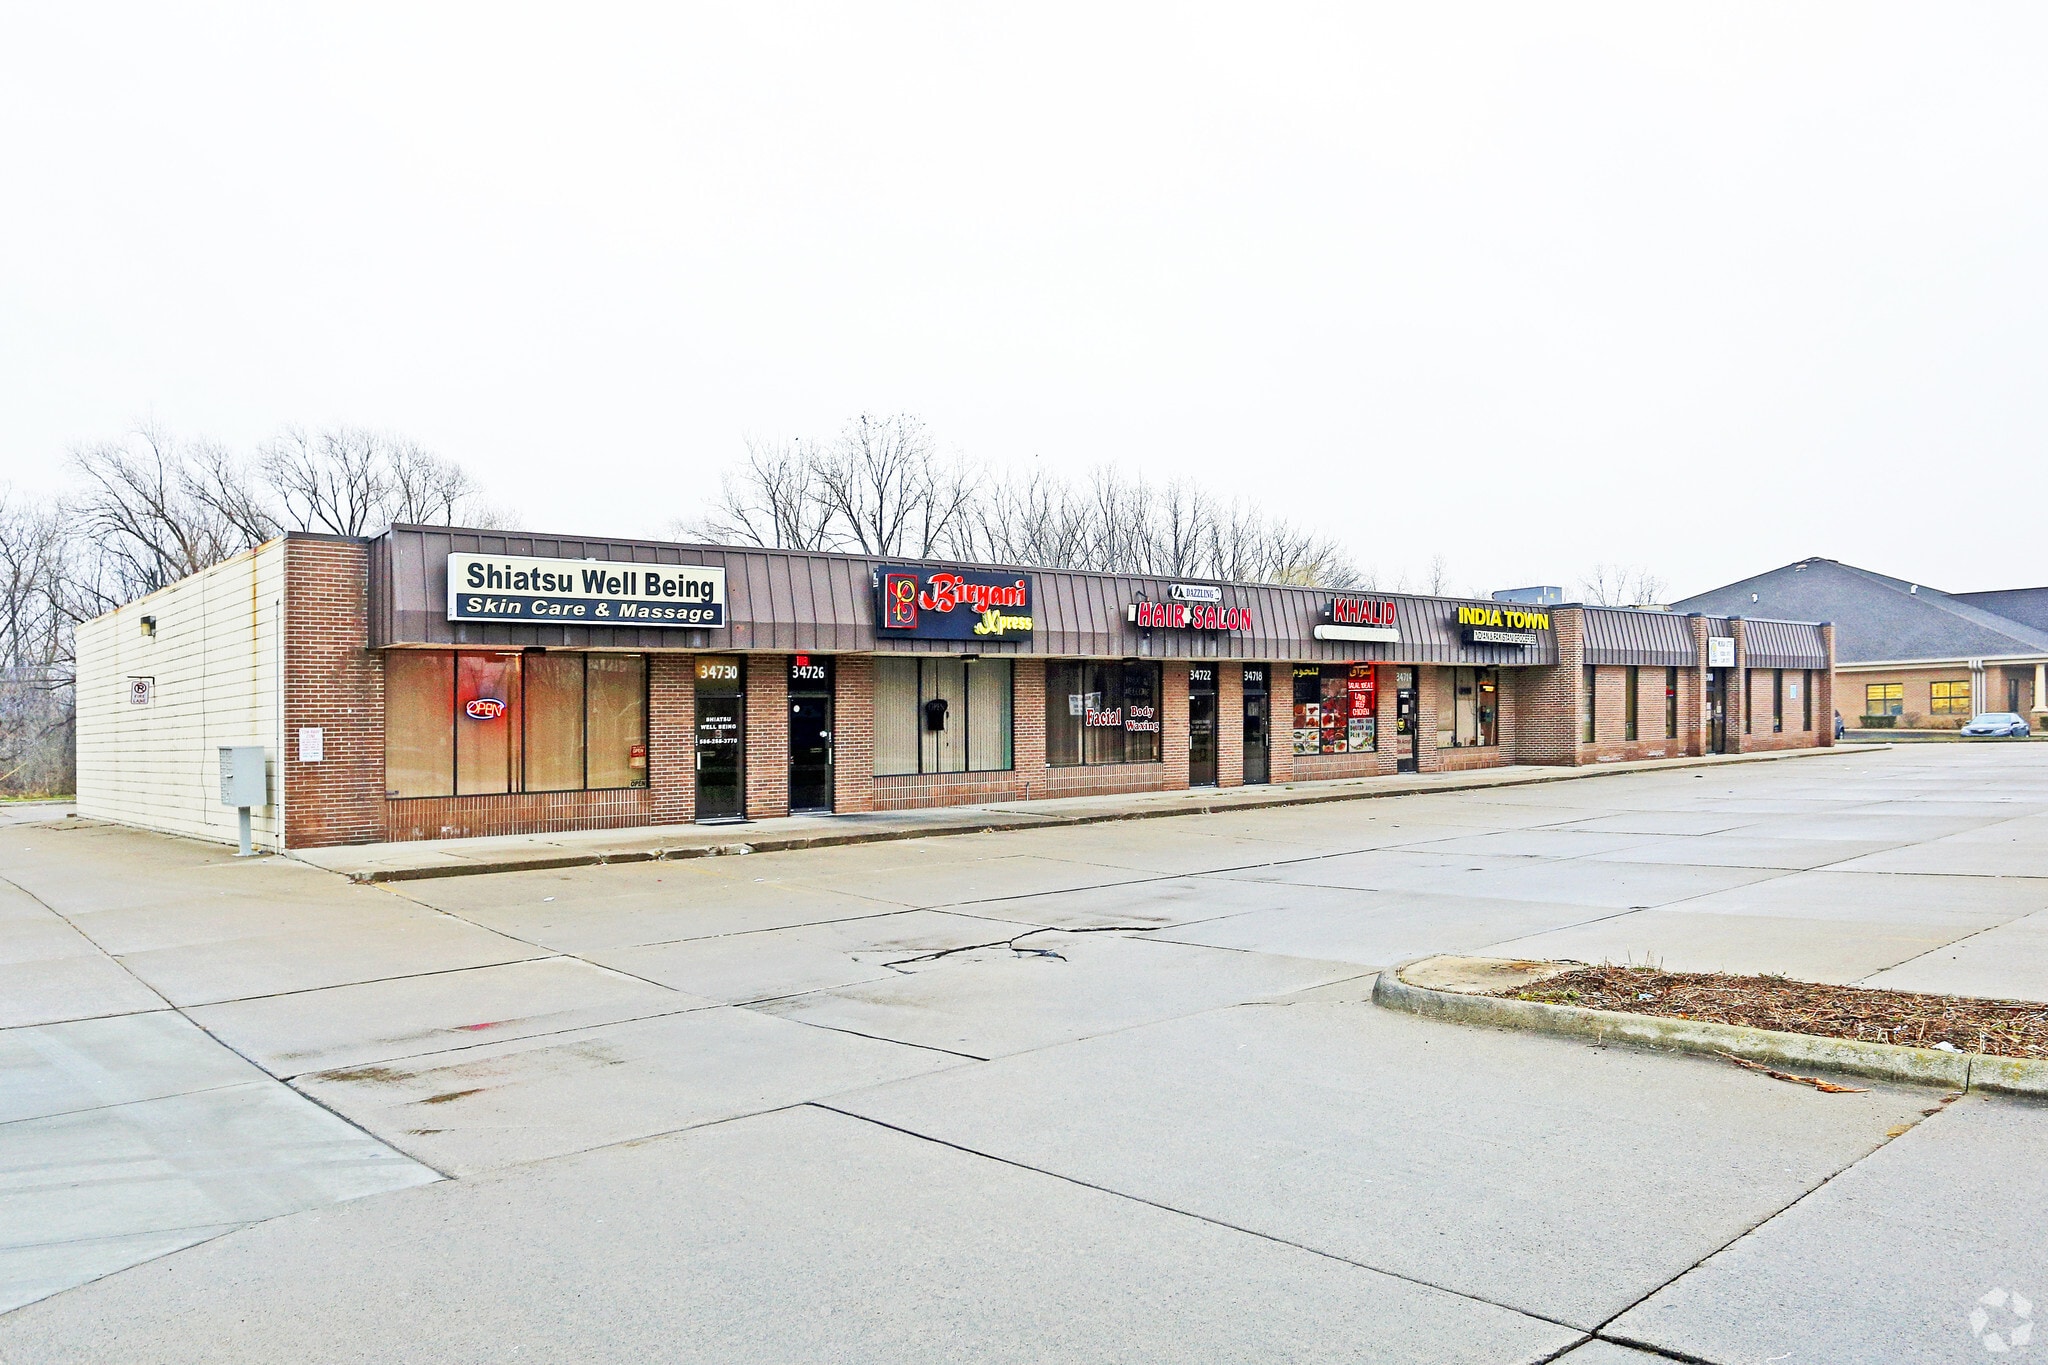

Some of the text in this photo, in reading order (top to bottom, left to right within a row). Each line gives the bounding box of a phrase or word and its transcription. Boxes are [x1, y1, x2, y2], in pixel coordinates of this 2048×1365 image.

[466, 562, 715, 603] Shiatsu Well Being
[918, 572, 1026, 614] Biryani
[1186, 588, 1214, 599] DAZZLING
[466, 597, 715, 623] Skin Care & Massage
[1137, 601, 1252, 632] HAIR SALON
[1333, 597, 1397, 626] KHALID
[1458, 607, 1550, 630] INDIA TOWN
[974, 609, 1033, 636] Xpress
[701, 665, 738, 679] 34730
[792, 666, 825, 679] 34726
[1189, 669, 1212, 681] 34722
[1244, 670, 1263, 682] 34718
[466, 700, 503, 717] OPEN
[1085, 706, 1122, 727] Facial
[1130, 706, 1154, 718] Body
[1125, 720, 1160, 733] Waxing
